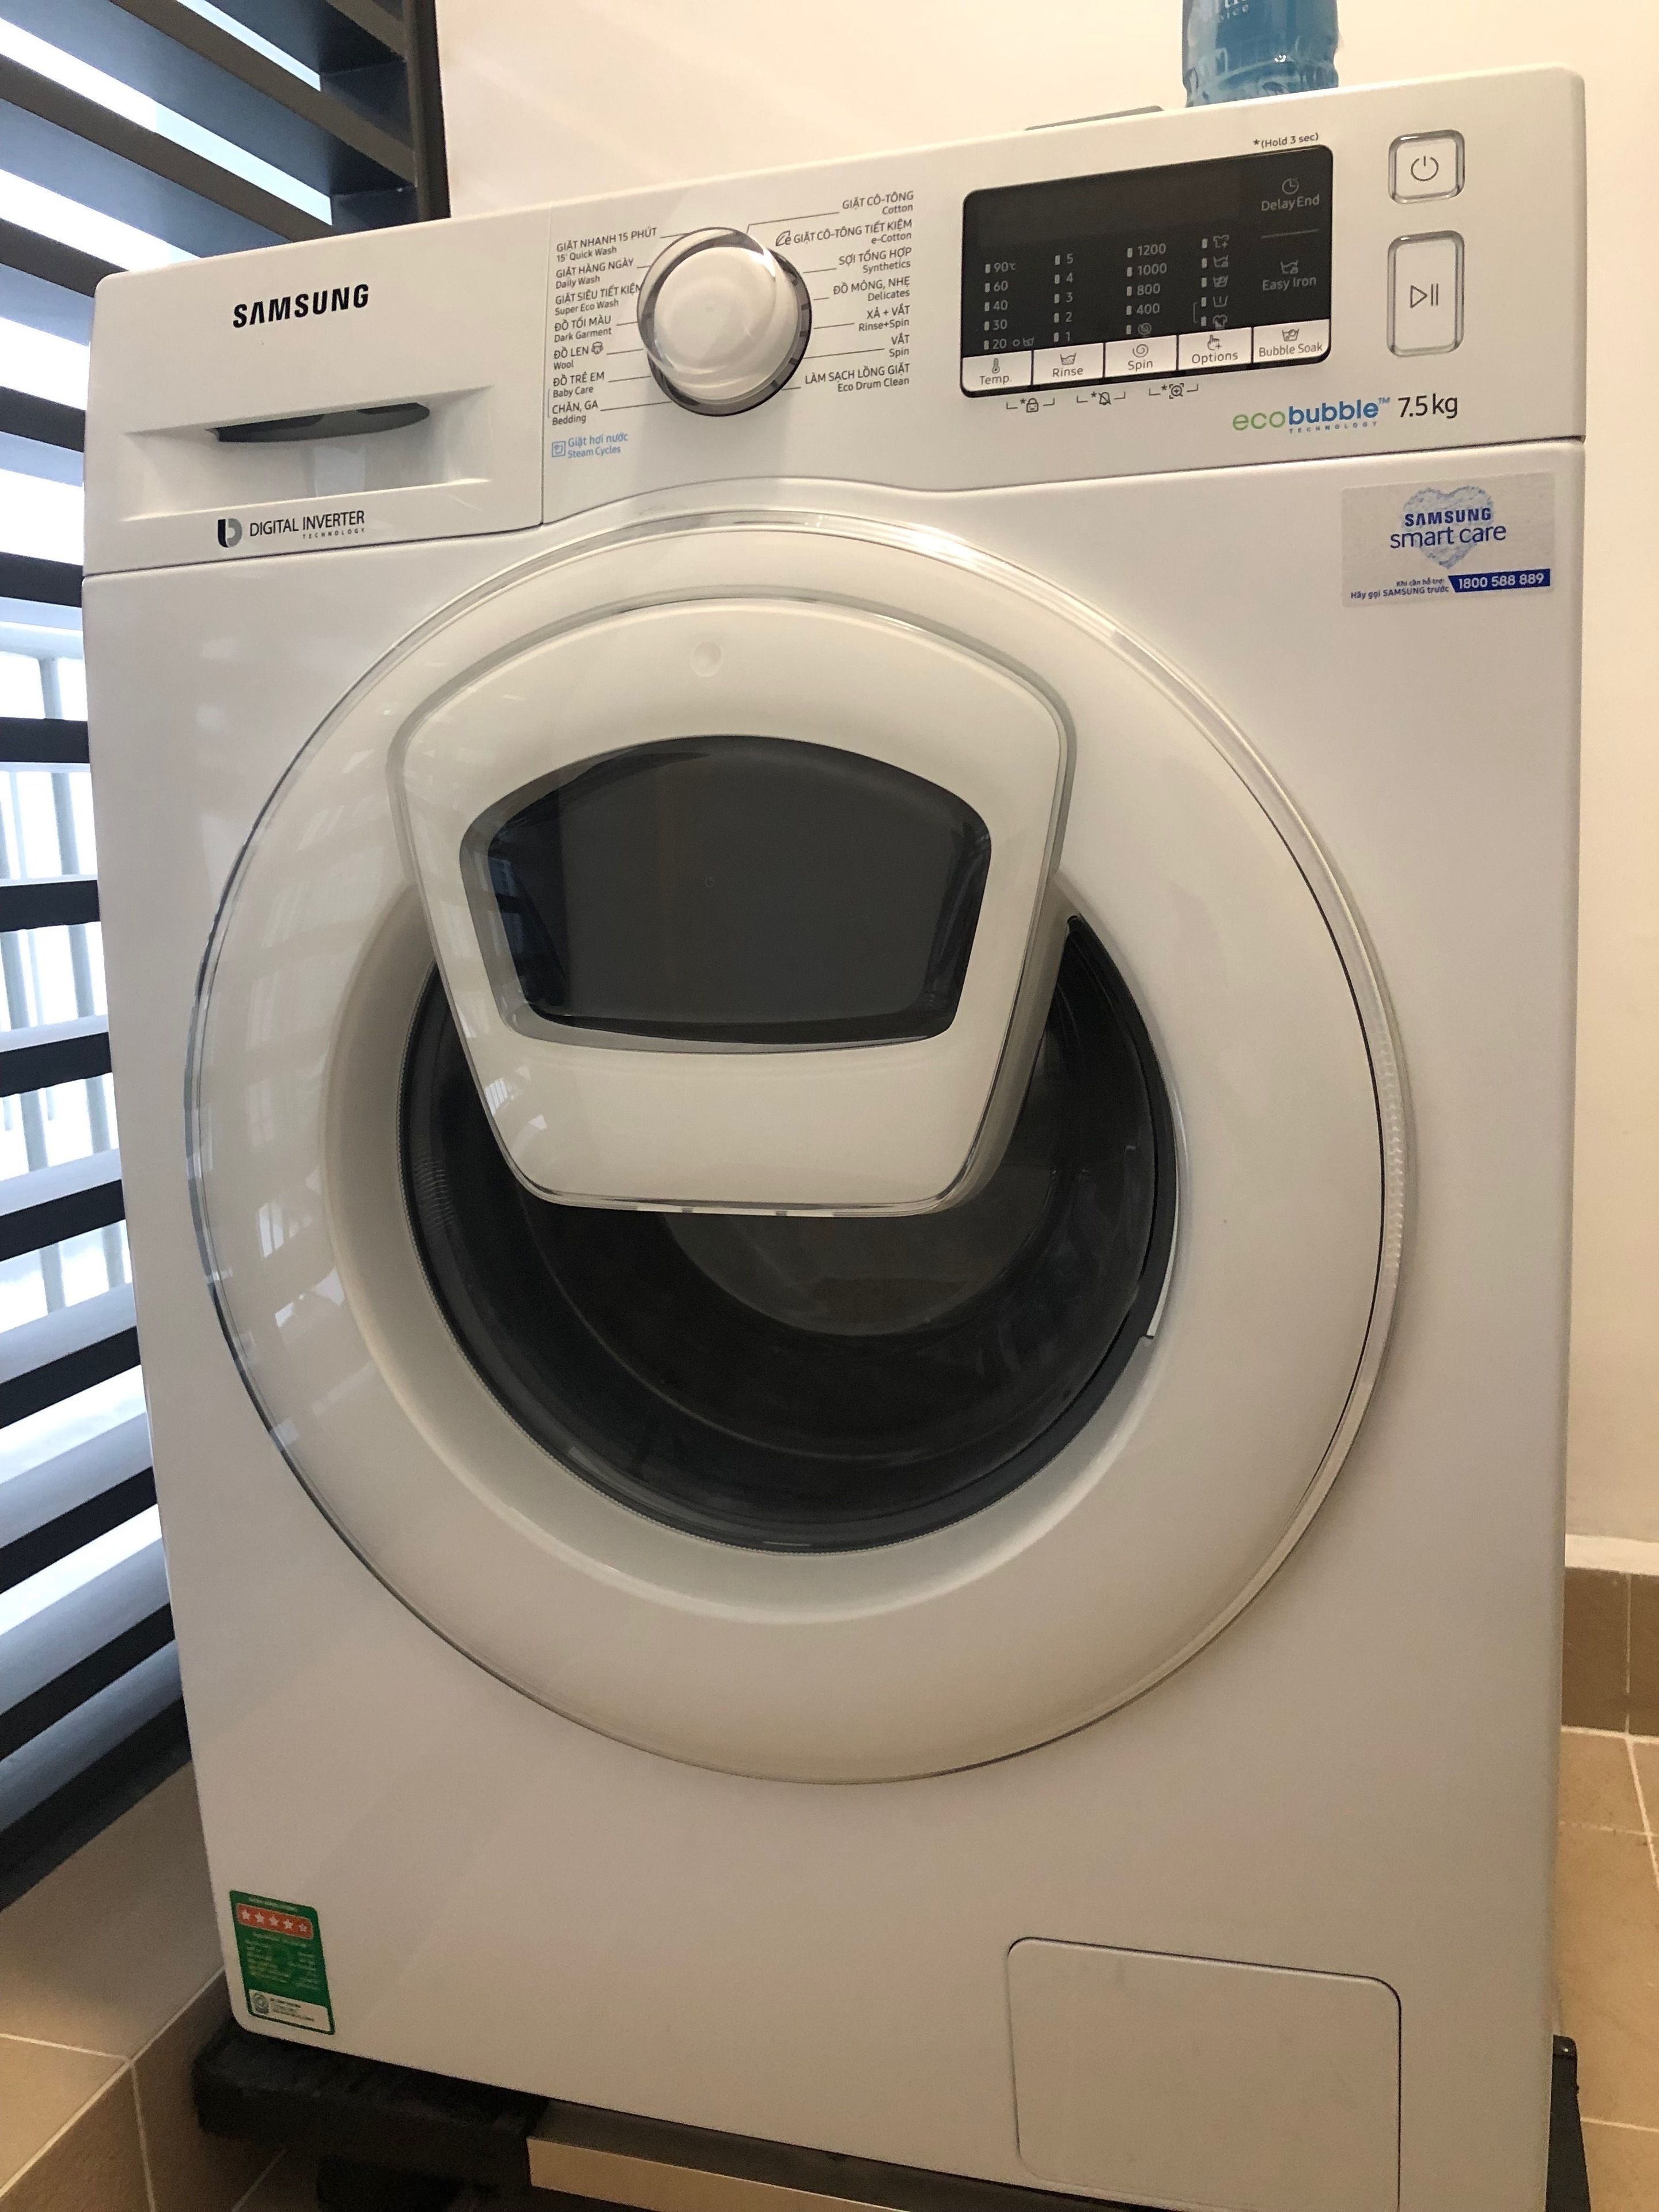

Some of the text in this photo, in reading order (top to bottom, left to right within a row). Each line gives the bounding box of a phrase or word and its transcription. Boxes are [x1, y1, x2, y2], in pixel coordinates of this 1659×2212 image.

[1290, 136, 1296, 144] 3
[1299, 132, 1319, 143] sec)
[842, 191, 914, 210] GIẶT CÔ-TÔNG
[882, 204, 913, 215] Cotton
[794, 232, 816, 244] GIẶT
[817, 226, 862, 240] CÔ-TÔNG
[865, 221, 885, 233] TIẾT
[888, 218, 912, 231] KIỆM
[556, 226, 657, 252] GIẶT NHANH 15 PHÚT
[871, 232, 912, 244] e-Cotton
[570, 250, 593, 261] Quick
[595, 246, 617, 256] Wash
[1138, 243, 1166, 256] 1200
[839, 254, 856, 266] SỢI
[889, 247, 912, 259] HỢP
[1067, 253, 1073, 264] 5
[556, 257, 634, 279] GIẶT HÀNG NGÀY
[863, 260, 911, 275] Synthetics
[1138, 263, 1167, 276] 1000
[556, 275, 600, 289] Daily Wash
[1066, 272, 1073, 283] 4
[1263, 276, 1316, 291] Easy Iron
[833, 276, 910, 295] ĐỒ MỎNG, NHẸ
[994, 281, 1008, 292] 60
[1137, 283, 1160, 296] 800
[555, 293, 575, 305] GIẶT
[578, 289, 598, 301] SIÊU
[600, 285, 619, 297] TIẾT
[868, 290, 910, 301] Delicates
[1066, 292, 1073, 302] 3
[233, 284, 369, 328] SAMSUNG
[555, 299, 619, 316] Super Eco Wash
[867, 307, 881, 319] XẢ
[892, 303, 910, 316] VẮT
[993, 300, 1007, 310] 40
[1137, 303, 1160, 315] 400
[554, 315, 611, 331] ĐỒ TỐI MÀU
[1066, 312, 1072, 322] 2
[859, 319, 909, 332] Rinse+Spin
[993, 319, 1007, 330] 30
[554, 327, 612, 342] Dark Garment
[891, 332, 910, 345] VẮT
[1066, 332, 1070, 342] 1
[993, 339, 1007, 349] 20
[1259, 342, 1323, 357] Bubble Soak
[554, 346, 589, 359] ĐỒ LEN
[889, 348, 909, 358] Spin
[1191, 351, 1238, 365] Options
[554, 359, 574, 370] Wool
[1128, 359, 1153, 371] Spin
[805, 362, 910, 384] LÀM SẠCH LỒNG GIẶT
[1052, 368, 1083, 377] Rinse
[553, 372, 604, 387] ĐỒ TRẺ EM
[838, 378, 909, 392] Eco Drum Clean
[553, 386, 593, 397] Baby Care
[552, 400, 599, 414] CHĂN, GA
[552, 415, 586, 426] Bedding
[1289, 421, 1378, 434] TECHNOLOGY
[568, 437, 586, 448] Giặt
[568, 445, 621, 459] Steam Cycles
[250, 510, 365, 537] DIGITAL INVERTER
[1404, 507, 1491, 527] SAMSUNG
[302, 528, 365, 539] TECHNOLOGY
[1391, 525, 1506, 548] smart care
[1458, 573, 1544, 589] 1800 588 889
[1383, 586, 1425, 597] SAMSUNG
